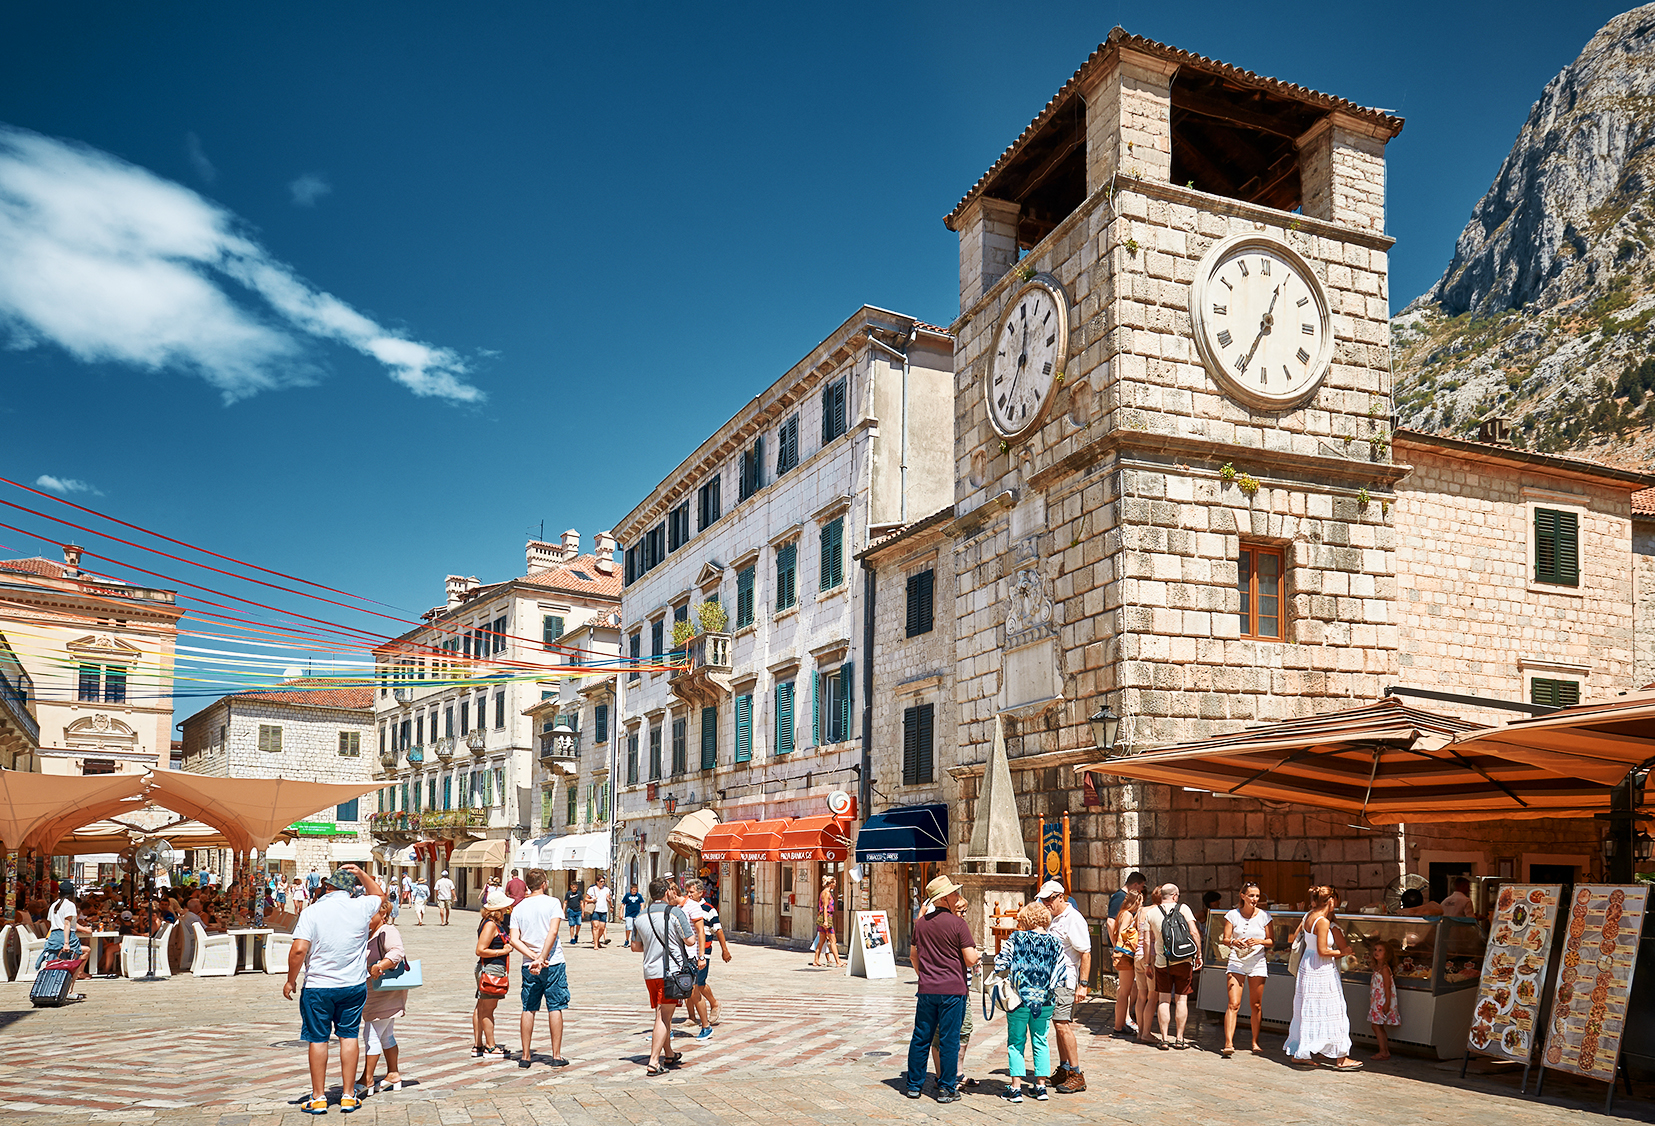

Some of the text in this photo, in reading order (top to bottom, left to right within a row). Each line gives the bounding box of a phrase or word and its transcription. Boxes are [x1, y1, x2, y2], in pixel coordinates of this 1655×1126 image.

[1237, 259, 1250, 277] XI
[1260, 258, 1271, 277] XII
[1220, 276, 1233, 291] X
[1283, 273, 1291, 286] I
[1213, 303, 1227, 315] IX
[1296, 297, 1309, 308] II
[1302, 323, 1315, 336] III
